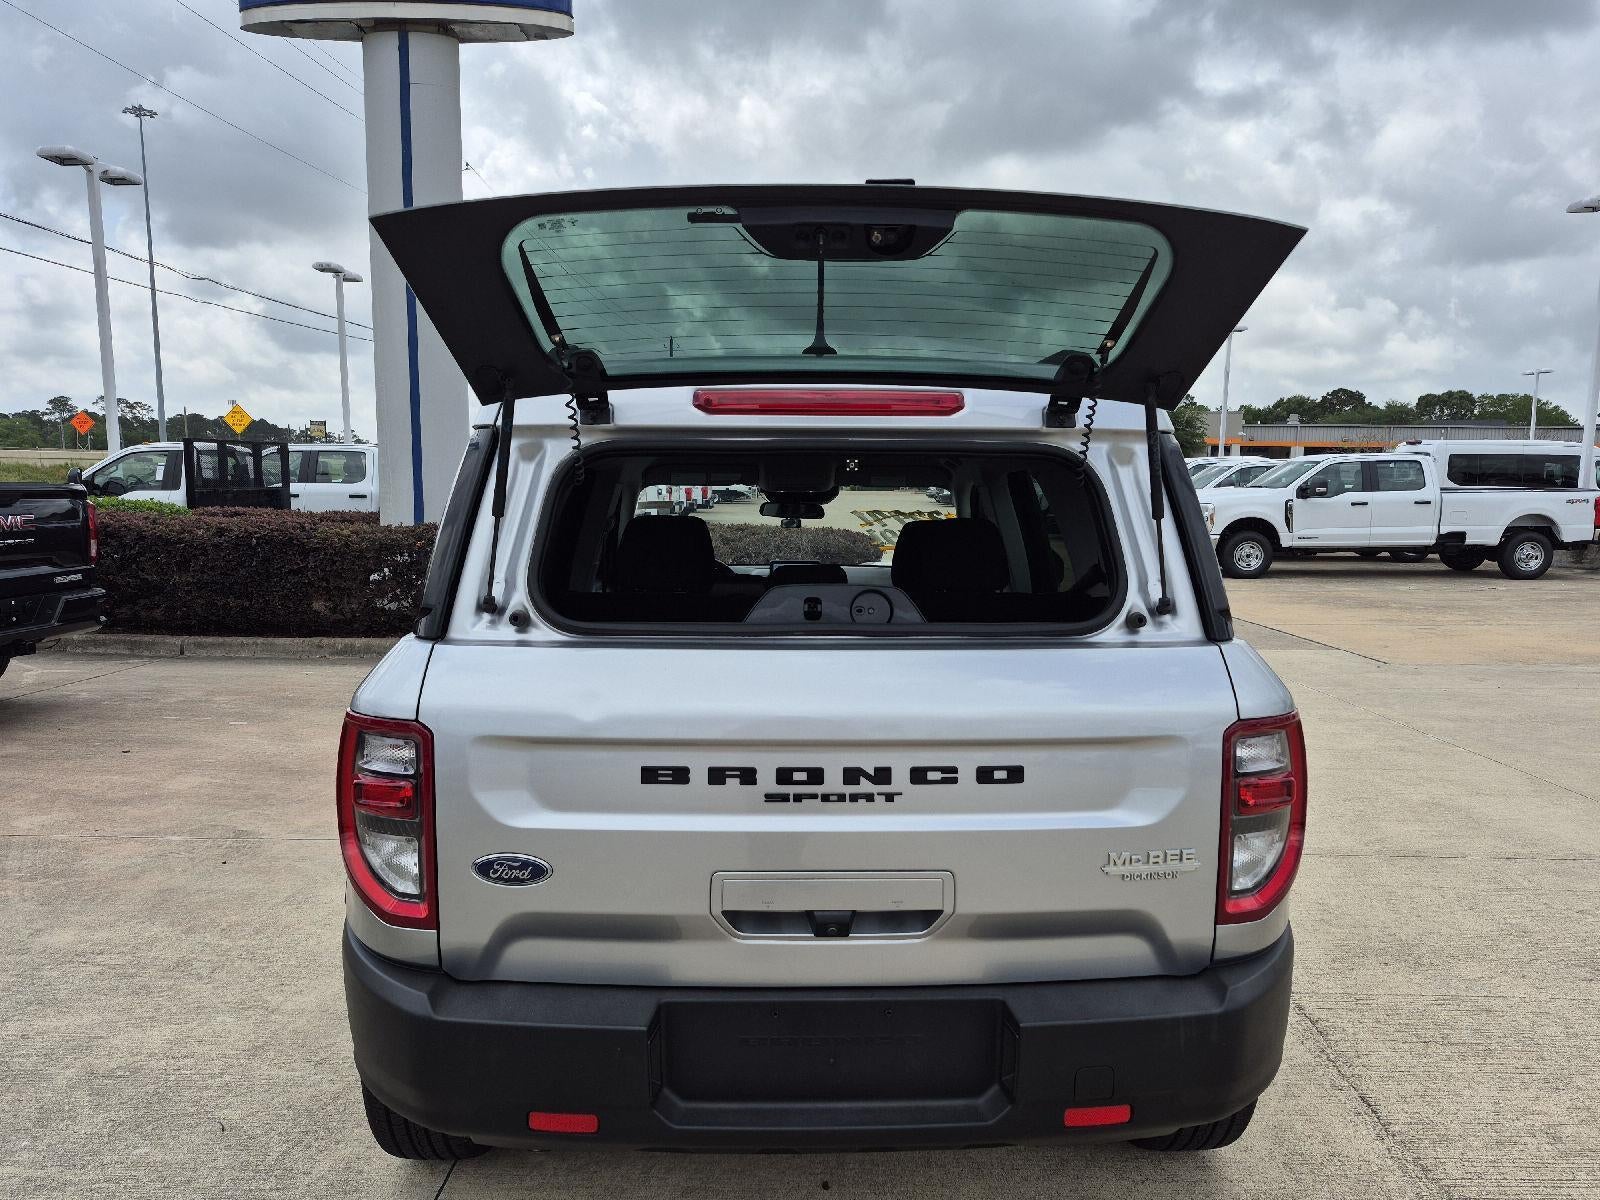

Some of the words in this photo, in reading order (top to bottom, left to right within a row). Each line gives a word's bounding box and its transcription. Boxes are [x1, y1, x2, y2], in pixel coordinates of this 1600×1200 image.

[640, 764, 1025, 787] BRONCO
[764, 791, 903, 803] SPORT
[489, 860, 533, 879] Ford
[1120, 870, 1179, 881] DICKINSON
